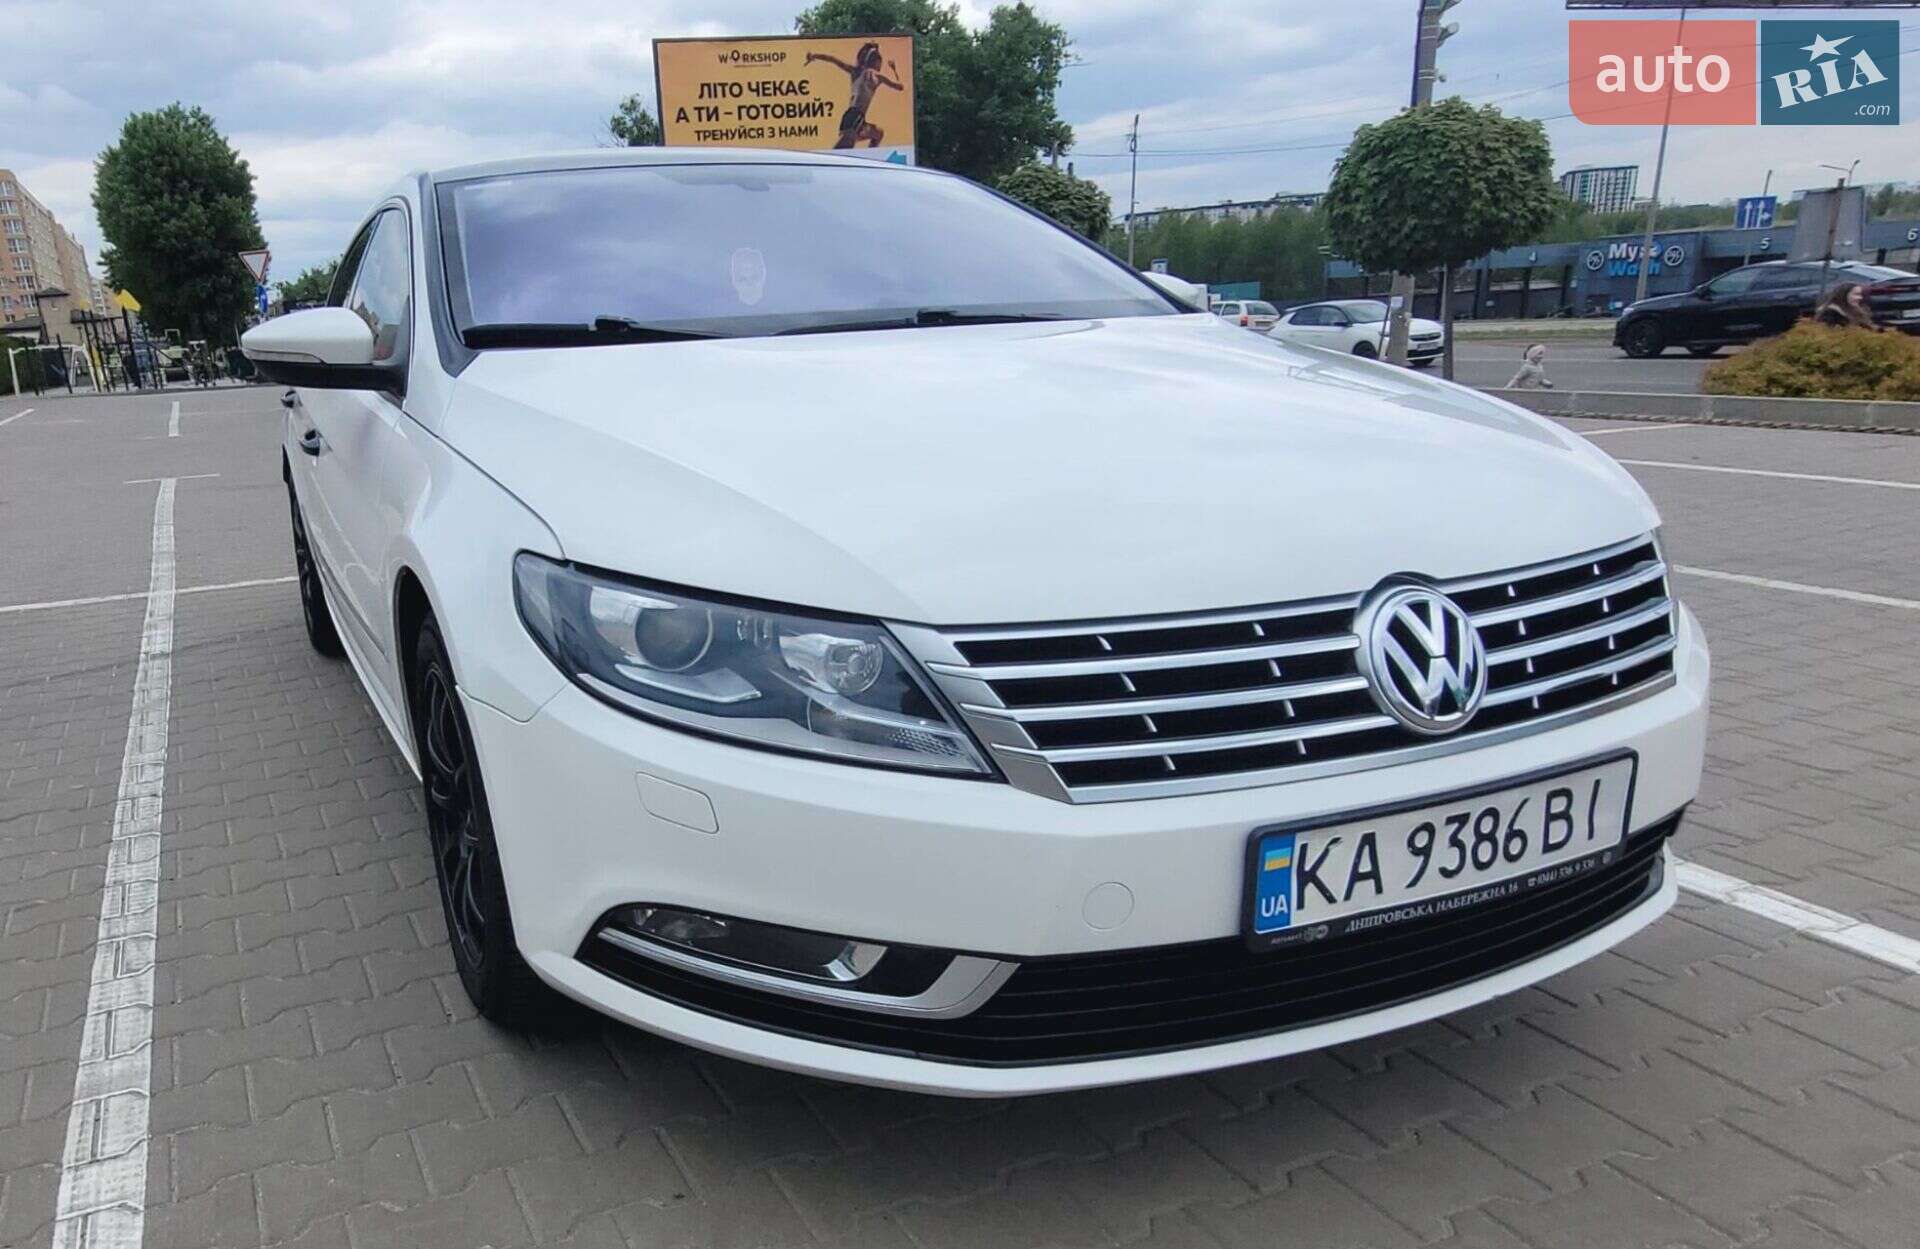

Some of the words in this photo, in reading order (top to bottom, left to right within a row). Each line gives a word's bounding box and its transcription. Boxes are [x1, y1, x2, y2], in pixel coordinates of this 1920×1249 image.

[718, 50, 787, 64] WORKSHOP
[698, 81, 743, 100] ЛІТО
[748, 79, 810, 98] ЧЕКАЄ
[675, 110, 689, 124] А
[694, 105, 719, 123] ТИ
[737, 98, 834, 121] ГОТОВИЙ?
[694, 126, 765, 142] ТРЕНУЙСЯ
[779, 125, 818, 139] НАМИ
[1907, 227, 1919, 241] 6
[1760, 237, 1771, 250] 5
[1608, 259, 1660, 276] Wah
[1296, 832, 1384, 911] KA
[1405, 797, 1531, 889] 9386
[1261, 893, 1289, 918] UA
